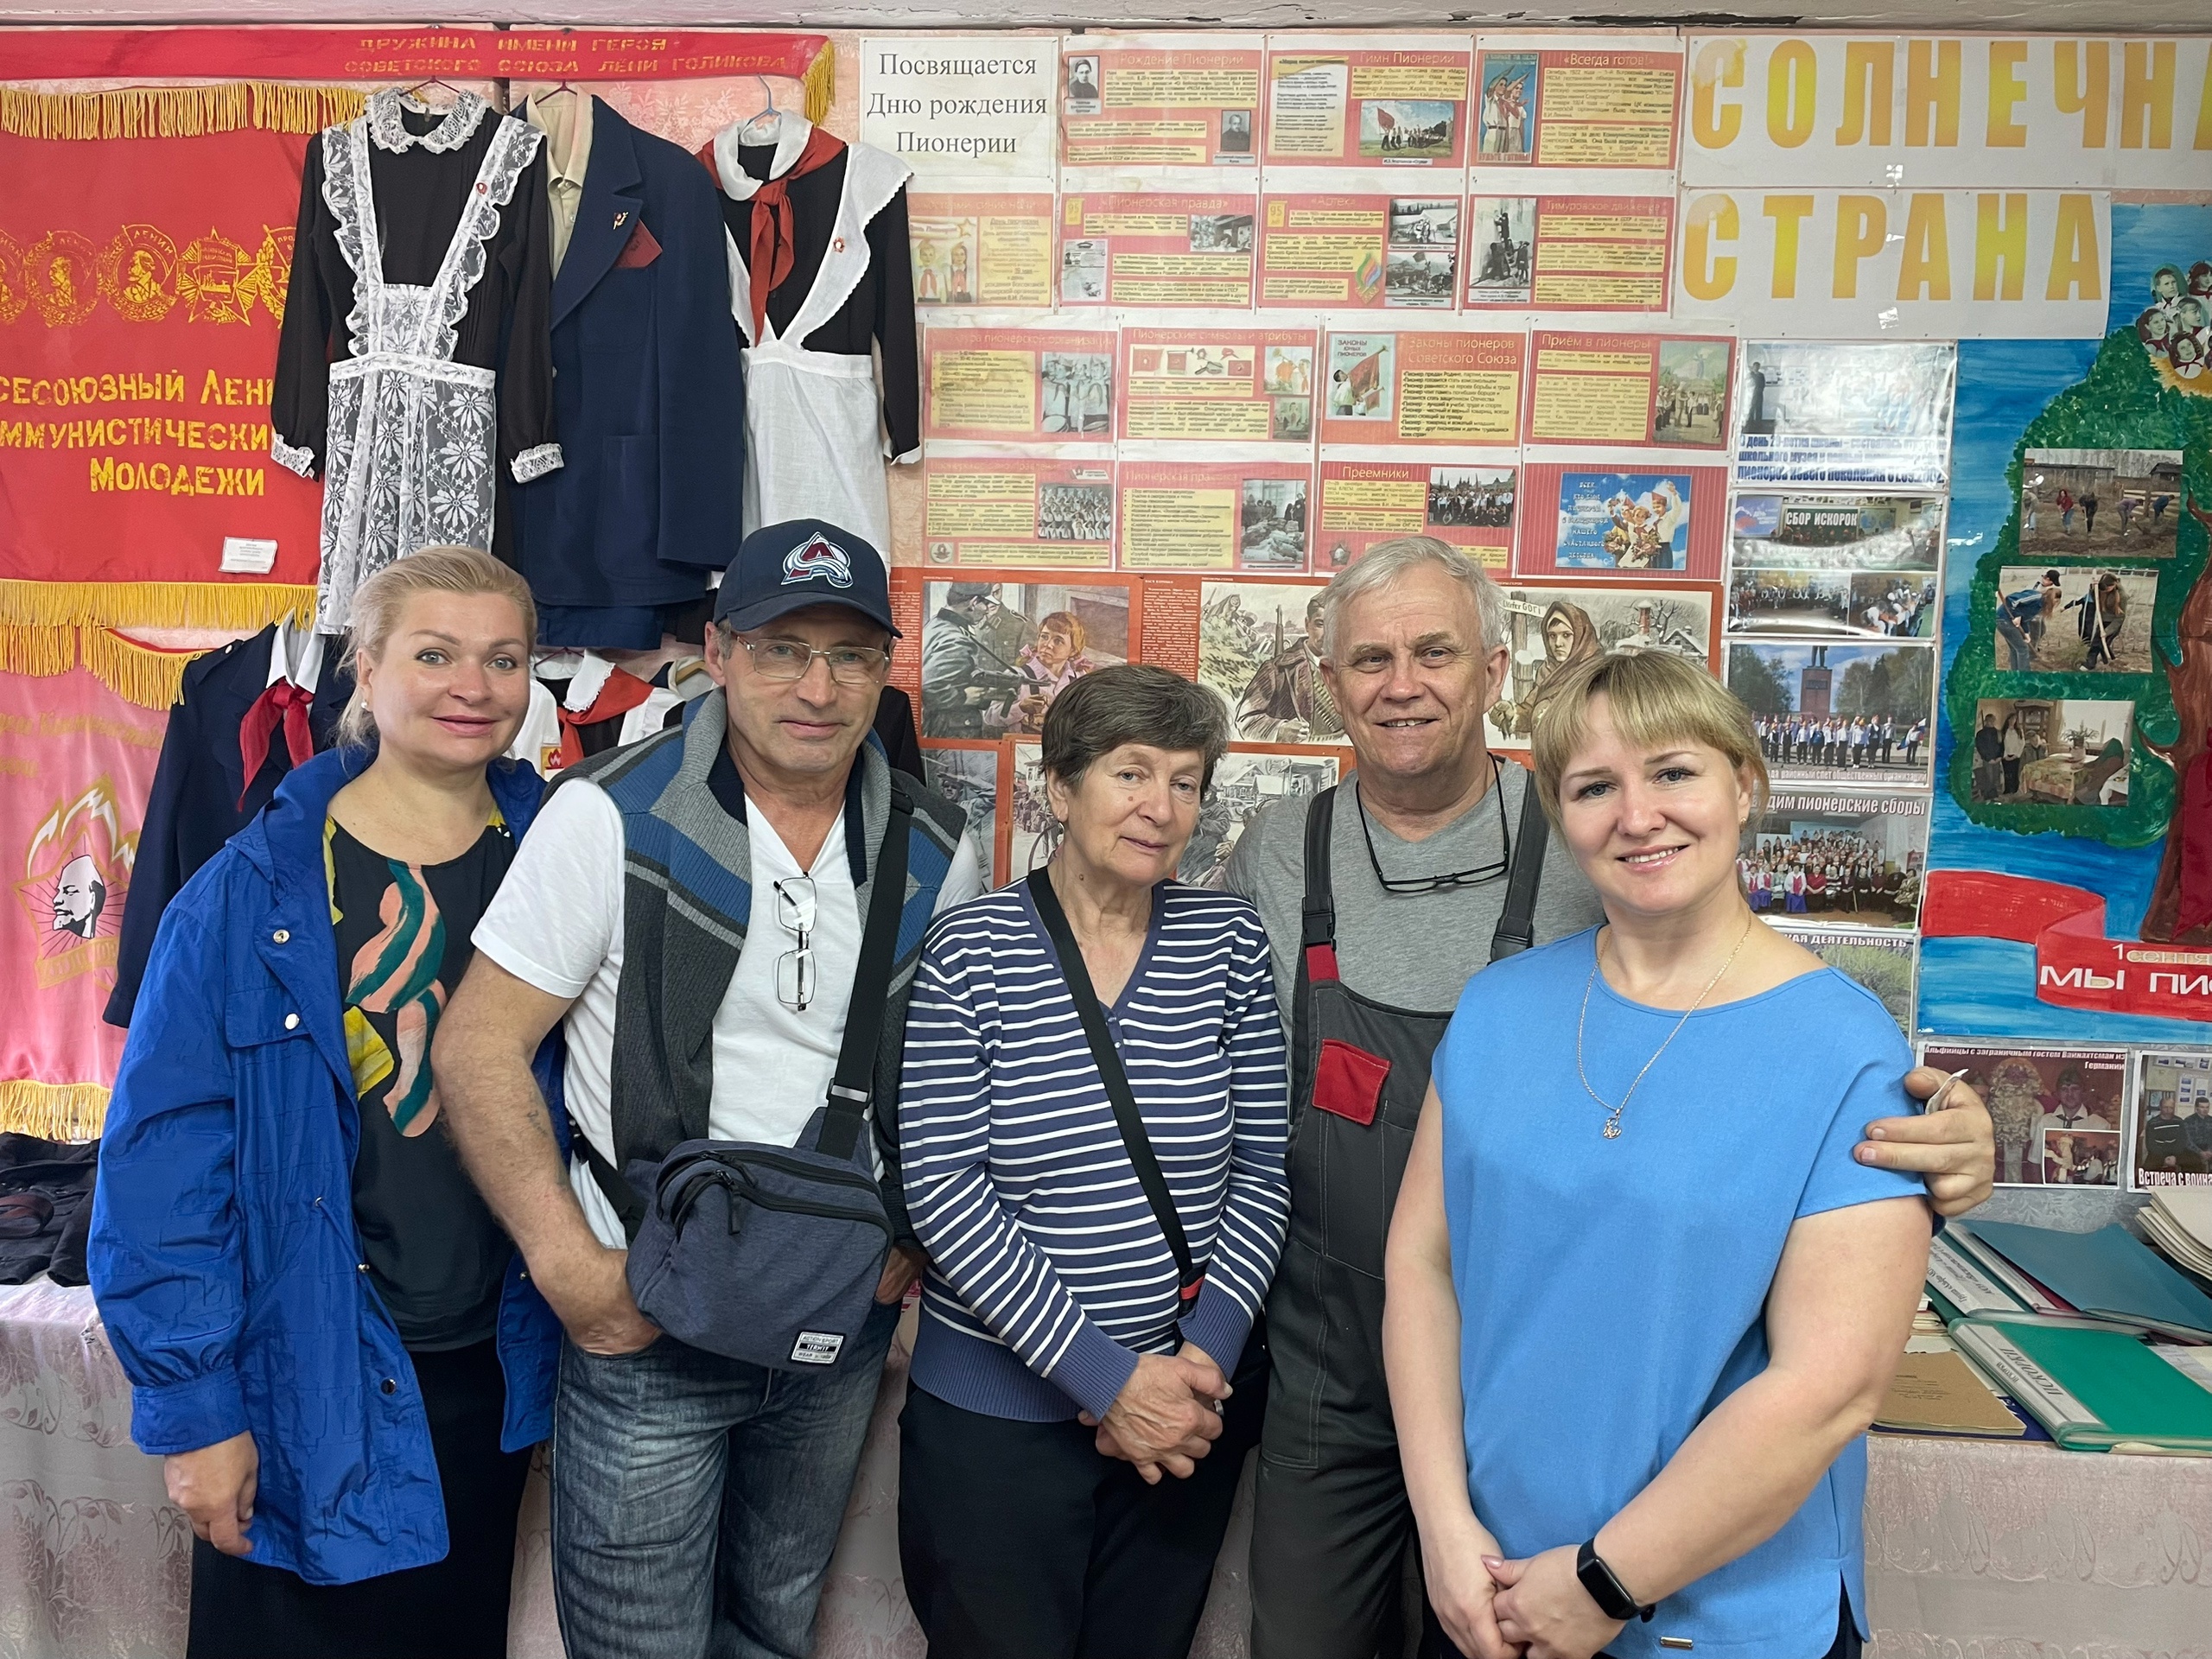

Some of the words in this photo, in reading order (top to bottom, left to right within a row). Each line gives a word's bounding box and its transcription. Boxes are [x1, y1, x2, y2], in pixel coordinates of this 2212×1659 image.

[357, 36, 476, 52] ДРУЖИНА
[498, 38, 577, 52] ИМЕНИ
[592, 38, 667, 52] ГЕРОЯ
[345, 58, 481, 73] СОВЕТСКОГО
[498, 59, 579, 73] СОЮЗА
[672, 54, 786, 71] ГОЛИКОВА
[879, 53, 1037, 78] Посвящается
[1120, 53, 1179, 67] Рождение
[1184, 53, 1244, 67] Пионерии
[1359, 52, 1389, 64] Гимн
[1393, 52, 1455, 66] Пионерии
[1563, 54, 1610, 66] «Всегда
[1691, 39, 2212, 150] СОЛНЕЧН
[867, 93, 922, 119] Дню
[930, 98, 1047, 119] рождения
[896, 131, 1017, 159] Пионерии
[1181, 198, 1229, 210] правда»
[133, 228, 175, 256] ЛЕНИН
[1682, 192, 2101, 301] СТРАНА
[1133, 328, 1197, 341] Пионерские
[1541, 334, 1582, 347] Приём
[1596, 338, 1651, 352] пионеры
[1409, 336, 1453, 349] Законы
[1456, 338, 1515, 352] пионеров
[1408, 353, 1473, 364] Советского
[1477, 353, 1517, 365] Союза
[0, 369, 184, 406] СЕСОЮЗНЫЙ
[0, 417, 275, 451] ММУНИСТИЧЕСКИ
[1746, 435, 1769, 448] день
[1738, 451, 1789, 462] школьного
[1790, 452, 1819, 464] музея
[90, 456, 264, 497] МОЛОДЕЖИ
[1343, 466, 1409, 480] Преемники
[1738, 466, 1788, 483] пионеров
[1786, 512, 1811, 525] СБОР
[1815, 512, 1858, 526] ИСКОРОК
[1767, 795, 1796, 811] дим
[1797, 796, 1878, 815] пионерские
[1880, 798, 1926, 817] сборы
[1810, 935, 1907, 948] ДЕЯТЕЛЬНОСТЬ
[2040, 965, 2125, 990] МЫ
[2149, 972, 2212, 995] ПИ
[1976, 1049, 2031, 1058] заграничным
[2085, 1061, 2125, 1070] Германии
[2139, 1167, 2177, 1185] Встреча
[2178, 1172, 2183, 1185] с
[1999, 1348, 2063, 1395] ИСКОРКИ
